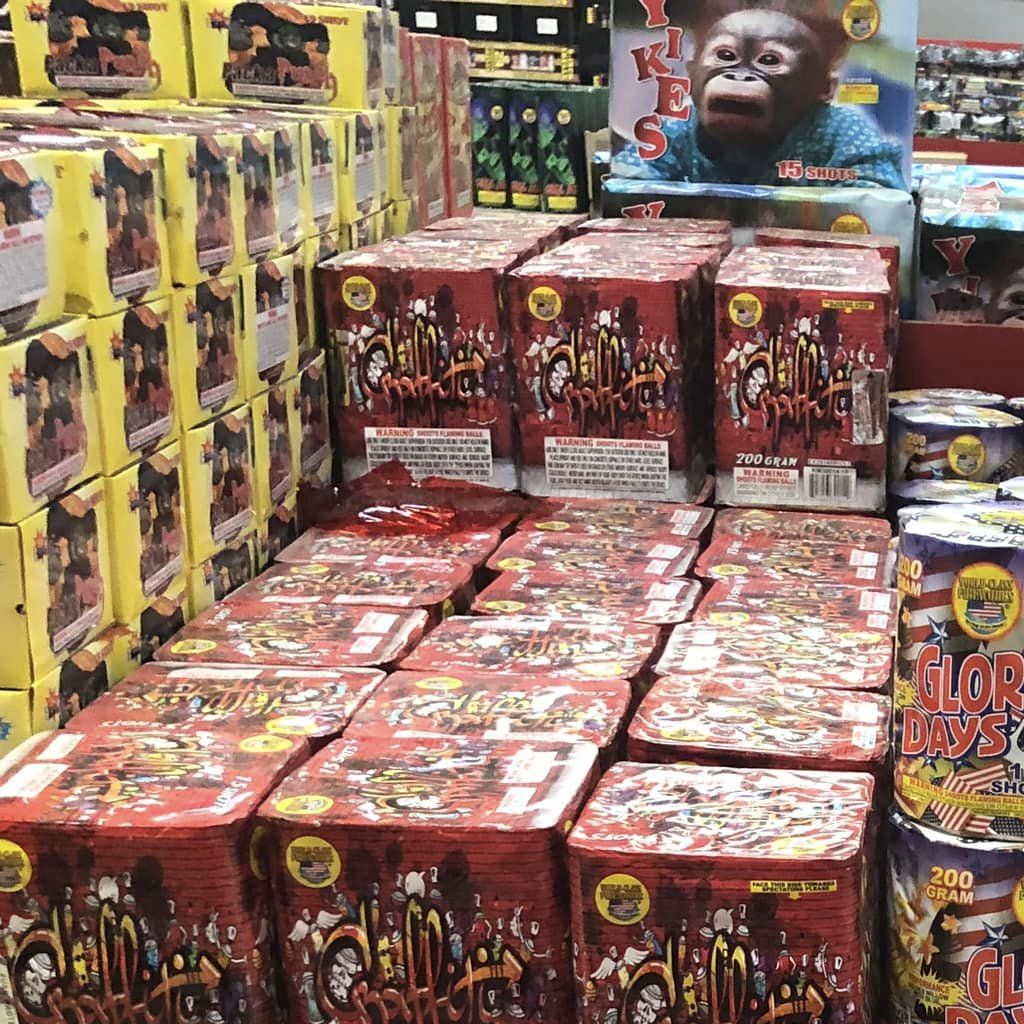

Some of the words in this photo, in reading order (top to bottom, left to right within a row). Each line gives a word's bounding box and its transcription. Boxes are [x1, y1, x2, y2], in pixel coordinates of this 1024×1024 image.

[776, 160, 803, 179] 15
[805, 165, 859, 181] SHOTS
[375, 428, 414, 438] WARNING
[555, 438, 594, 447] WARNING
[735, 453, 763, 465] 200
[764, 456, 798, 467] GRAM
[743, 469, 790, 478] WARNING
[900, 705, 1011, 760] DAYS
[928, 864, 974, 890] 200
[926, 884, 975, 905] GRAM
